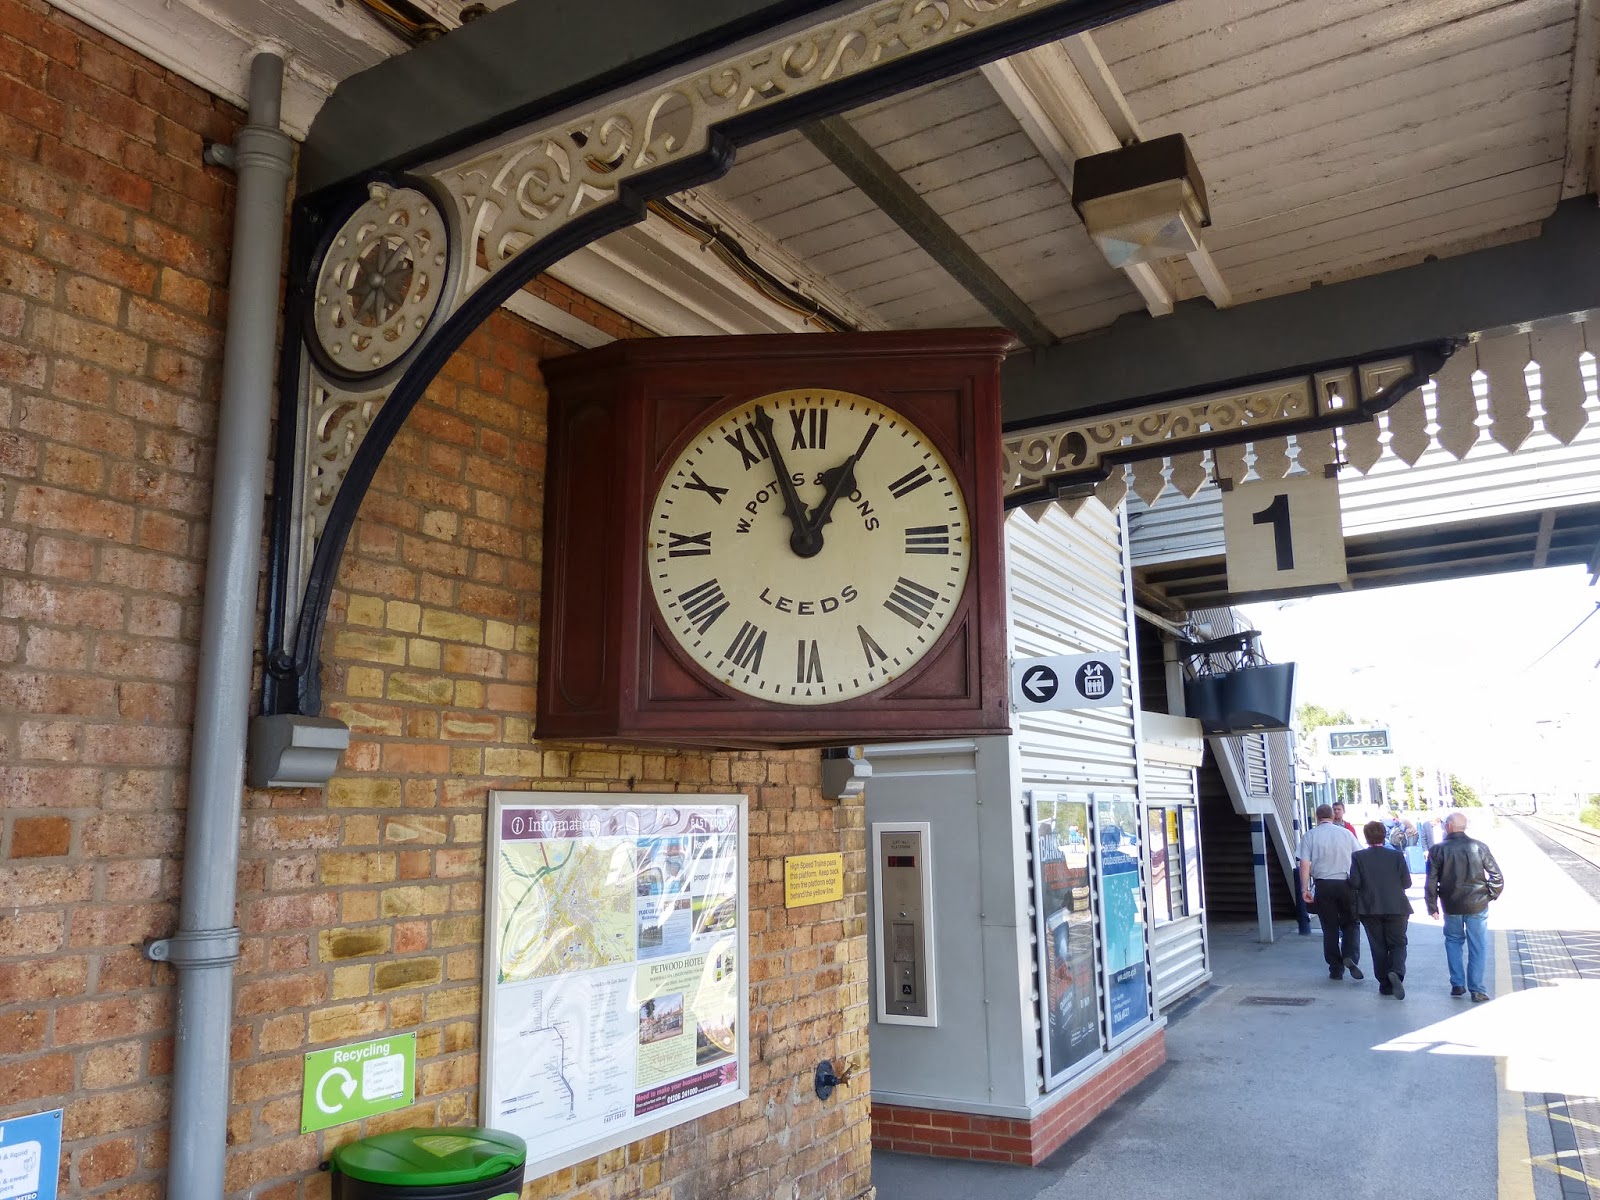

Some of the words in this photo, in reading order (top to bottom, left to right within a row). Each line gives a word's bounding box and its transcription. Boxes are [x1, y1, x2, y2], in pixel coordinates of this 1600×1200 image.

[736, 472, 806, 535] W.POTS
[1253, 494, 1294, 571] 1
[759, 584, 859, 616] LEEDS
[528, 816, 600, 832] Information
[800, 861, 814, 870] Speed
[650, 960, 684, 975] PETWOOD
[684, 957, 705, 968] HOTEL
[333, 1043, 390, 1064] Recycling
[10, 1149, 28, 1158] liquid
[10, 1173, 29, 1183] sweet
